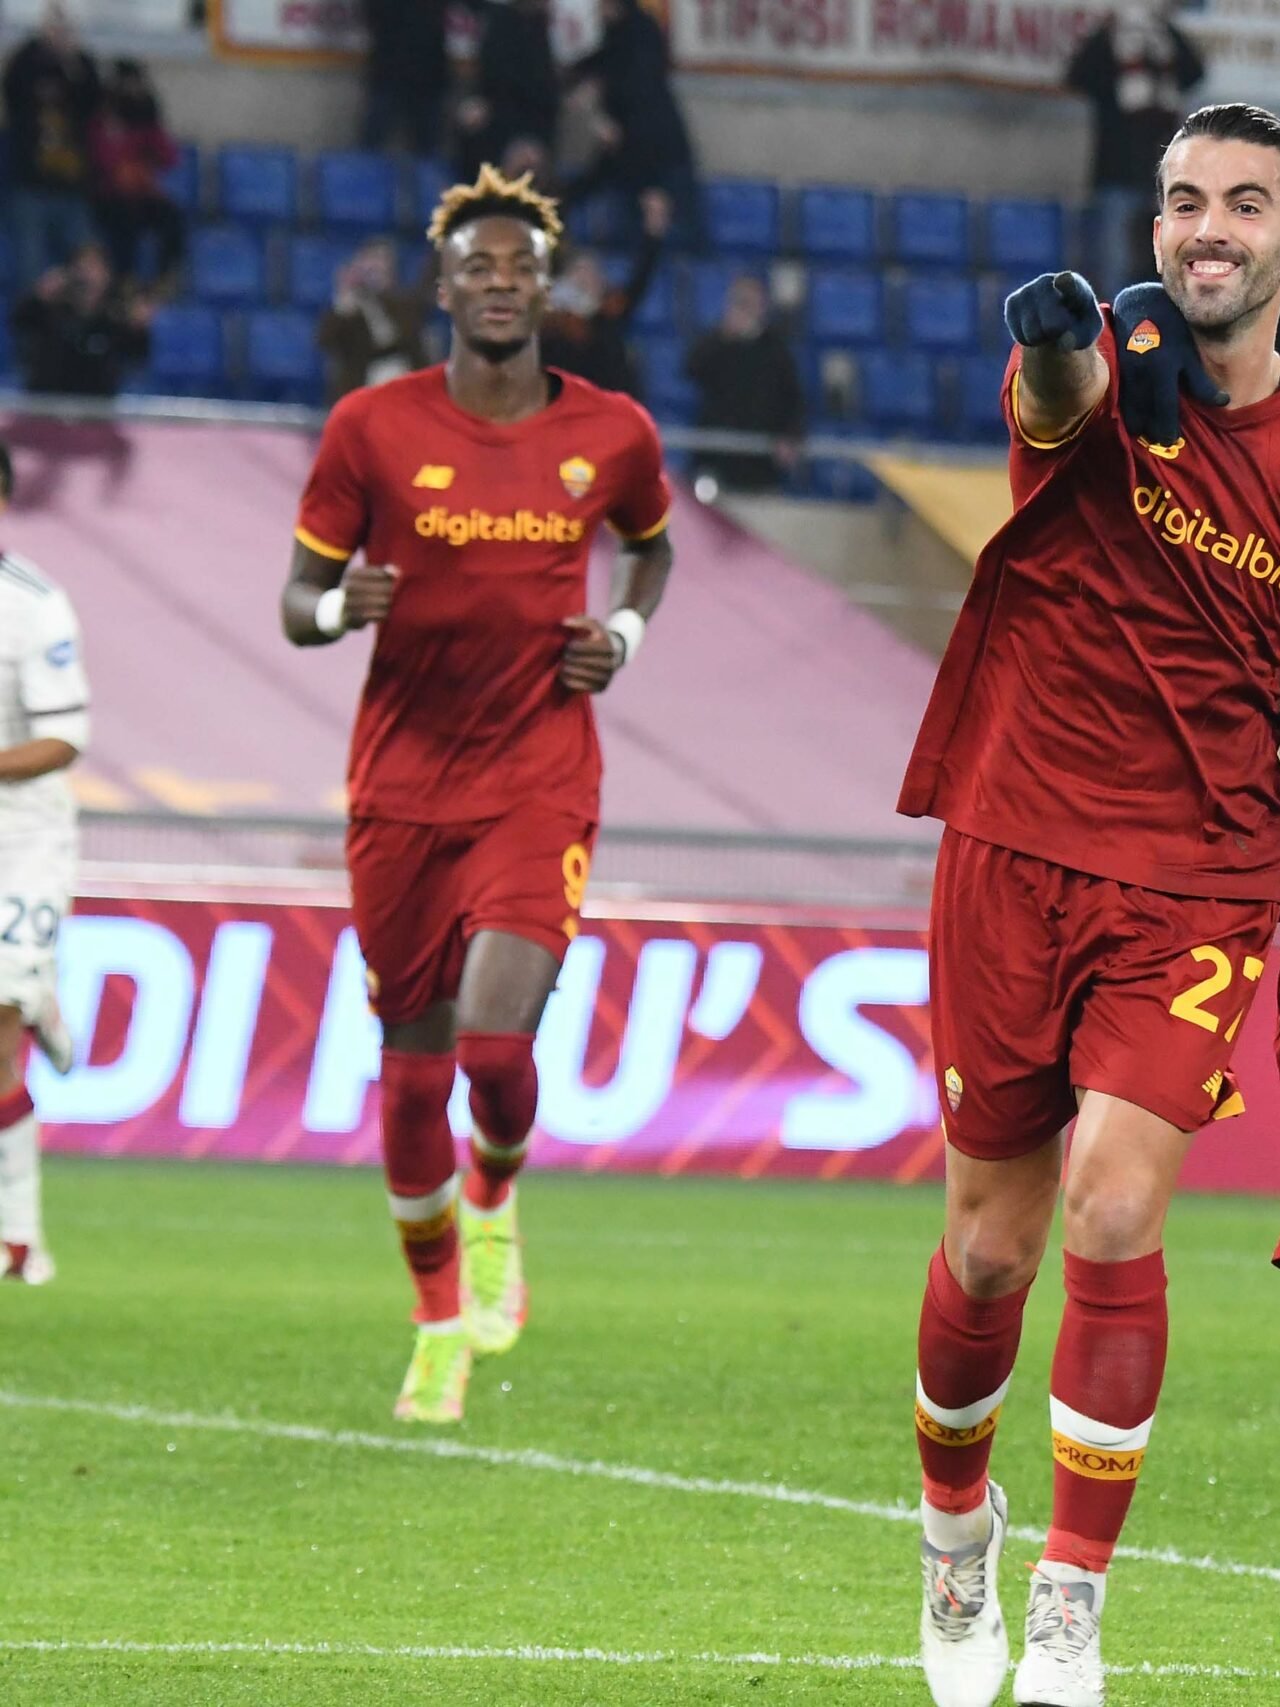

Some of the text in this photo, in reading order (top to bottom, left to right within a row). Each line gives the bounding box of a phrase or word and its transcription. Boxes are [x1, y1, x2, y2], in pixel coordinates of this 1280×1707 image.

[415, 506, 585, 546] digitalbits
[561, 842, 589, 910] 9
[1, 895, 60, 950] 29
